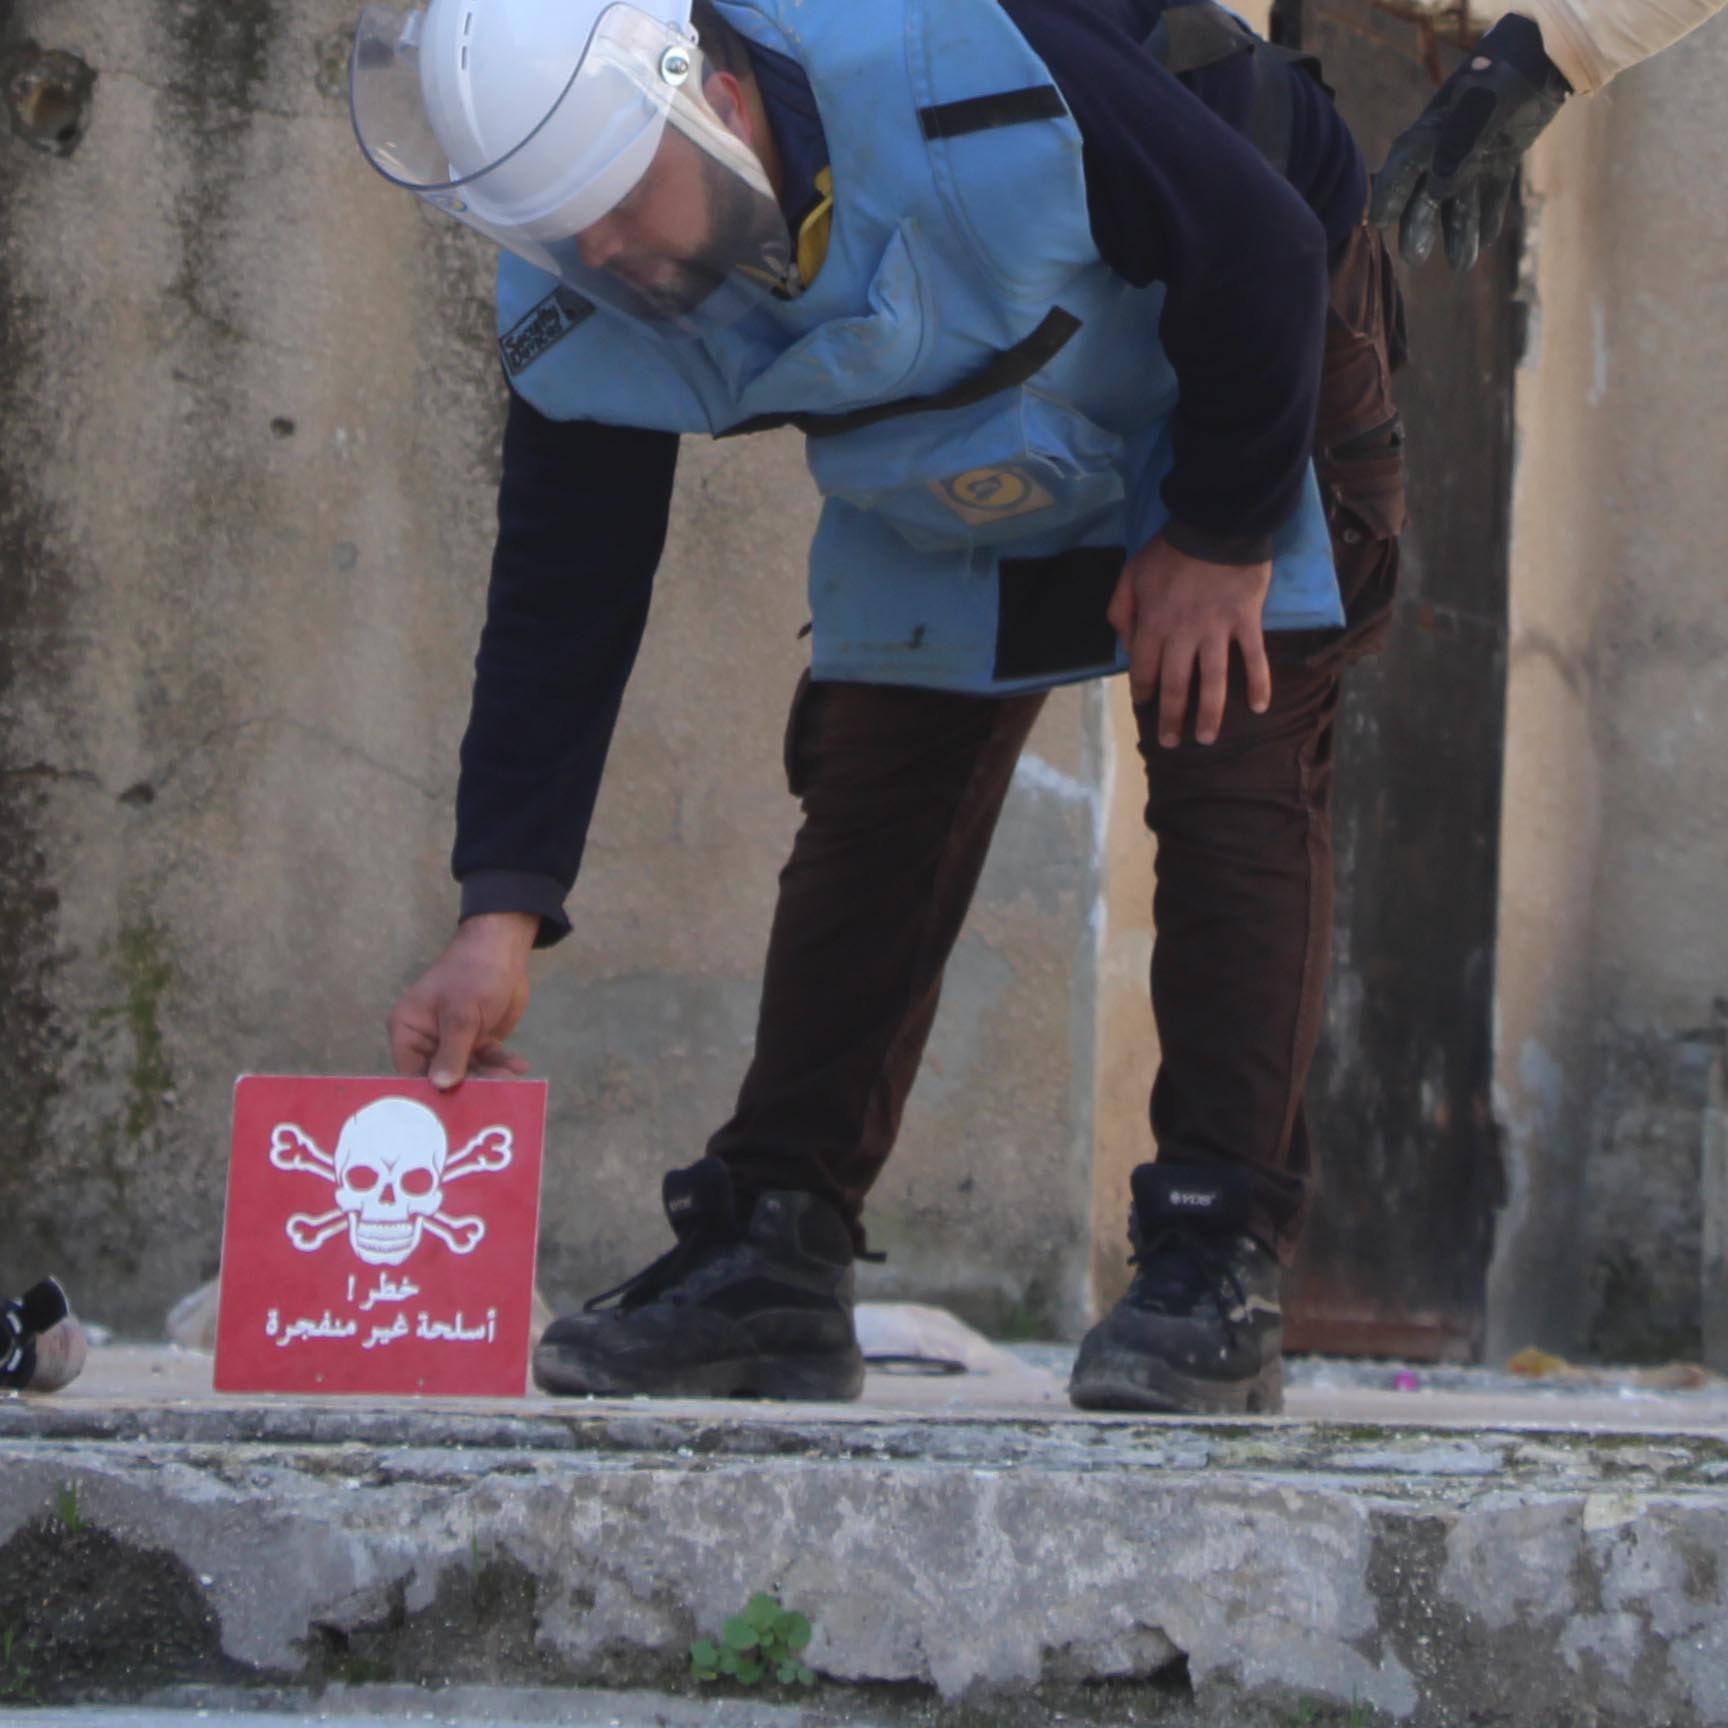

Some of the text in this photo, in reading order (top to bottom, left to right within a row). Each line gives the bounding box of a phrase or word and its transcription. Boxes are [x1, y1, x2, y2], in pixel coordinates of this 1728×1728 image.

[357, 1270, 420, 1311] خطر
[264, 1307, 498, 1349] أسلحة غير منفجرة
